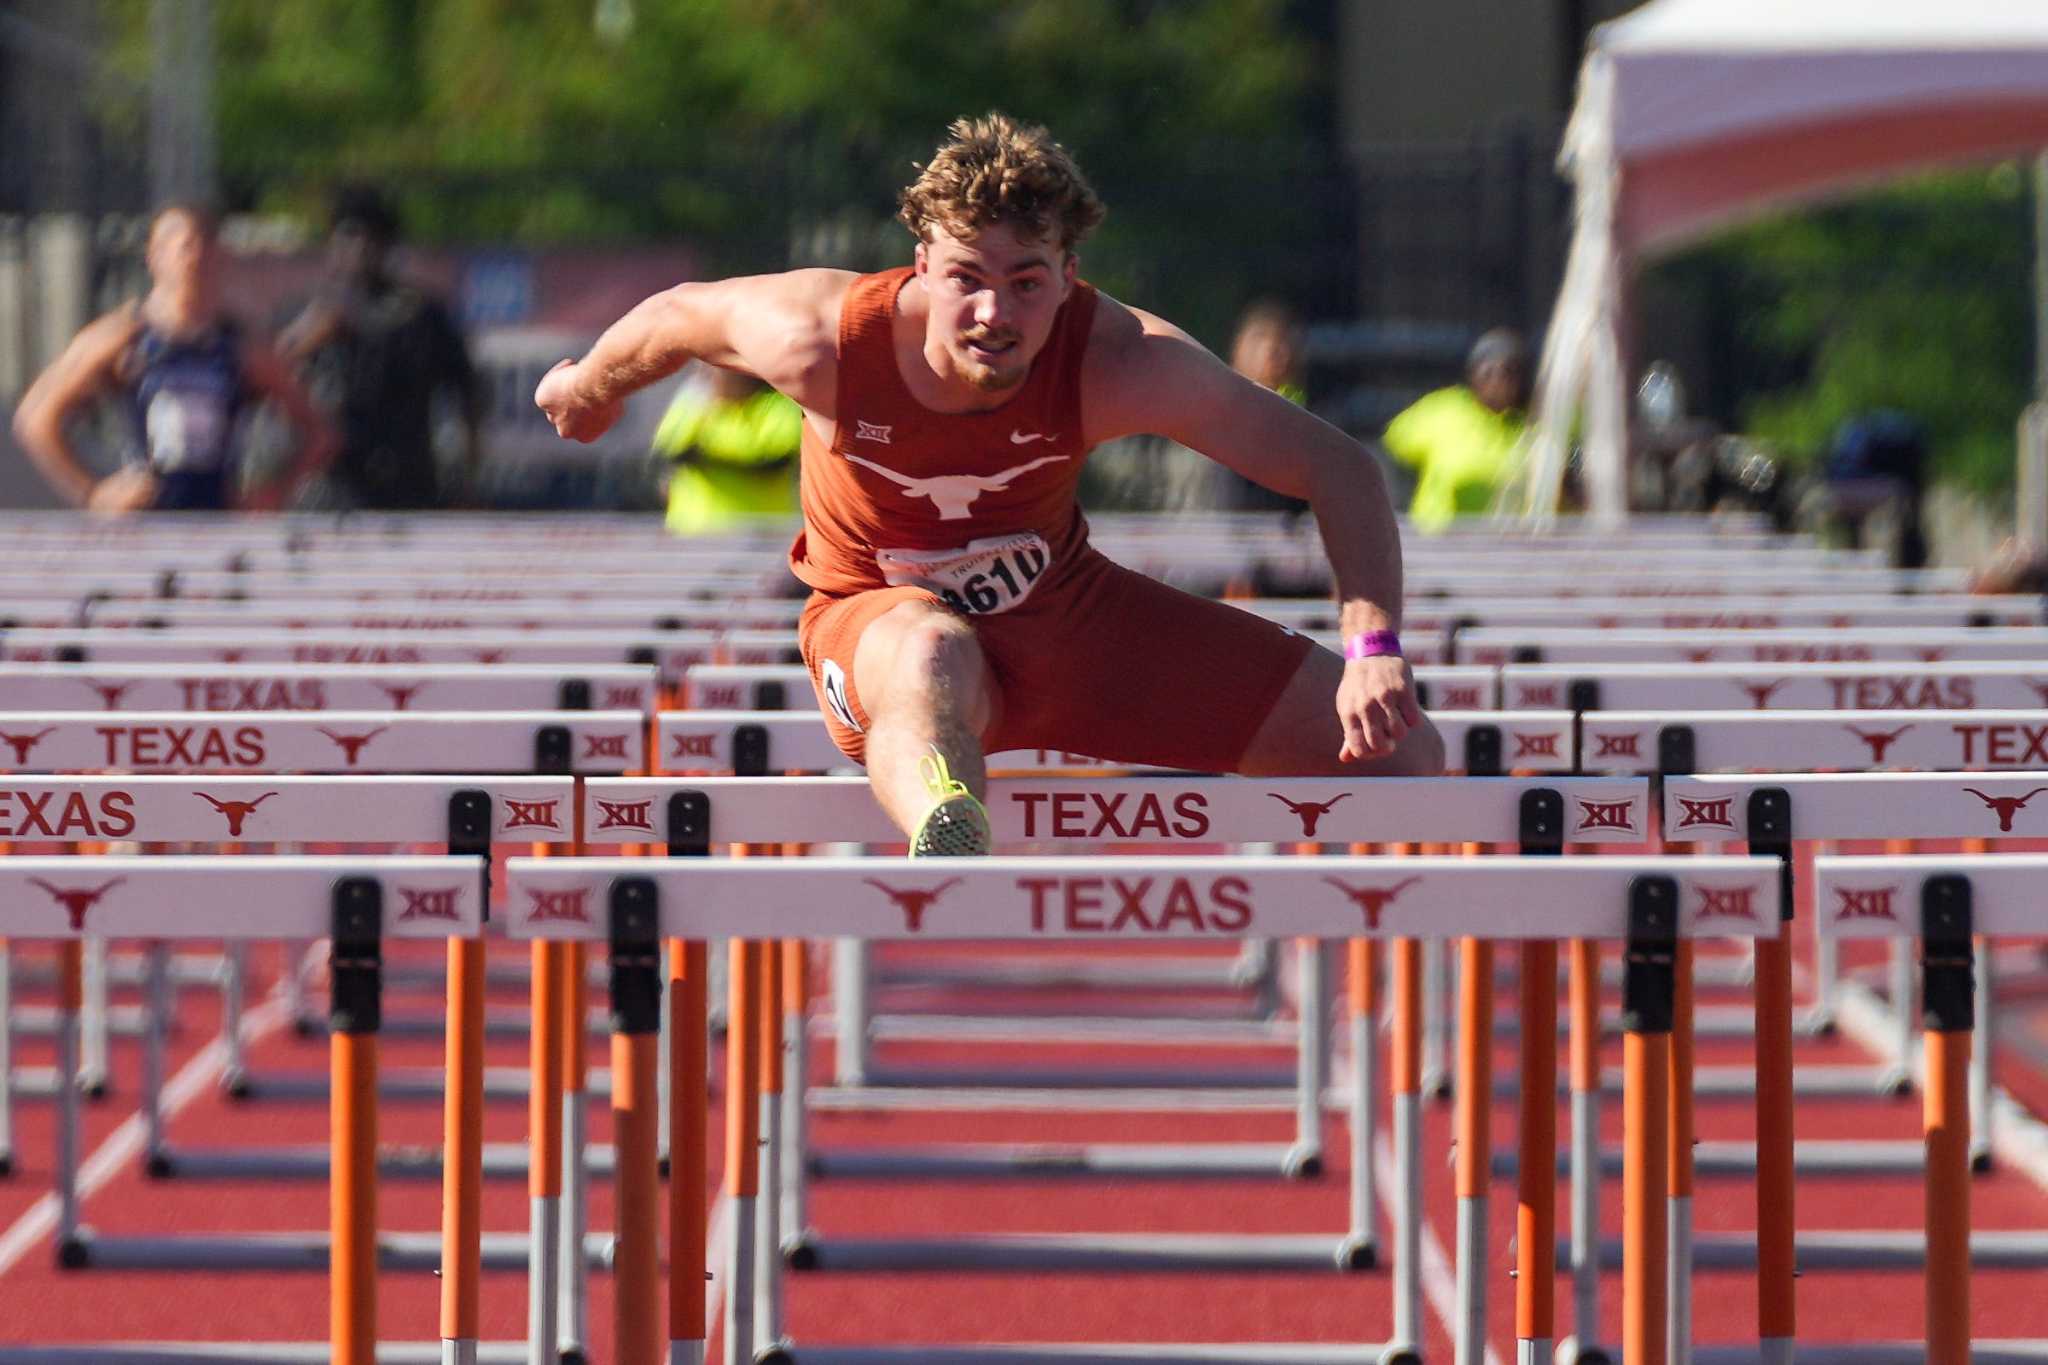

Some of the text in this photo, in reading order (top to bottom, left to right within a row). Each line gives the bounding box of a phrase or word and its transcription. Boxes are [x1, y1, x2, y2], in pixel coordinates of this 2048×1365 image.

[180, 679, 326, 711] TEXAS
[1827, 677, 1975, 710] TEXAS
[97, 727, 265, 766] TEXAS
[505, 800, 559, 830] XII
[598, 800, 652, 830] XII
[1012, 792, 1210, 838] TEXAS
[1580, 800, 1633, 830] XII
[1680, 798, 1733, 828] XII
[398, 886, 461, 921] XII
[527, 886, 592, 922] XII
[1017, 876, 1253, 931] TEXAS
[1693, 885, 1758, 920] XII
[1835, 886, 1899, 920] XII
